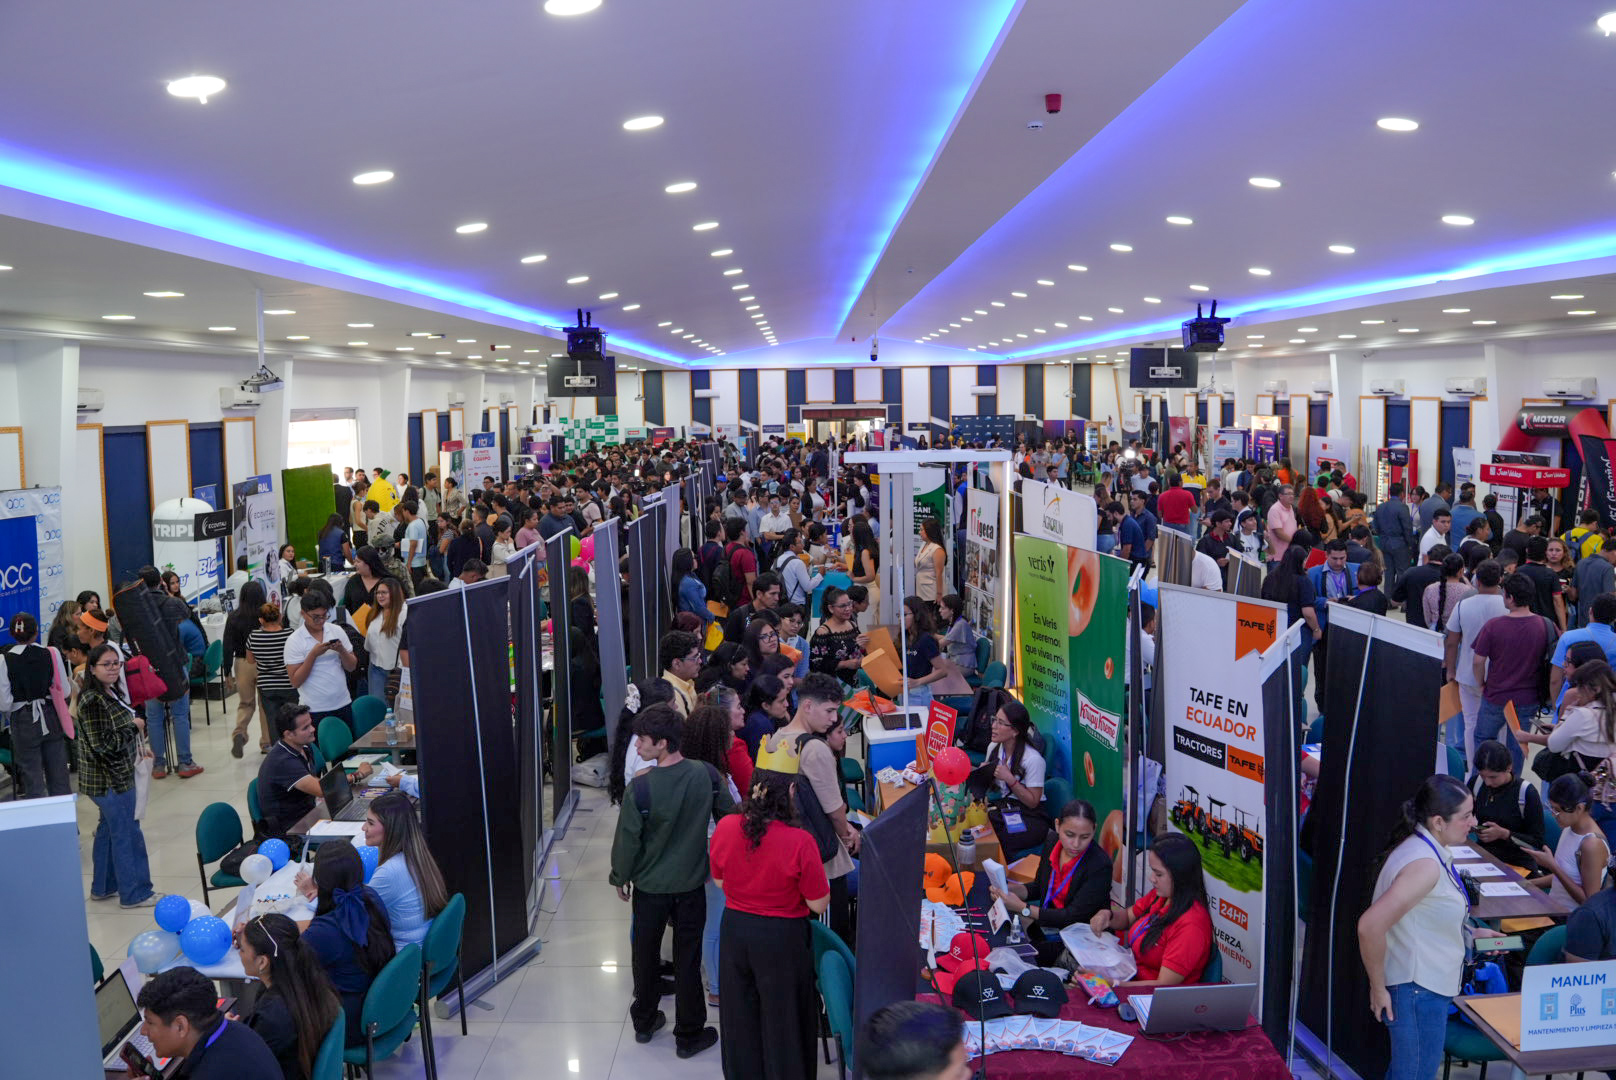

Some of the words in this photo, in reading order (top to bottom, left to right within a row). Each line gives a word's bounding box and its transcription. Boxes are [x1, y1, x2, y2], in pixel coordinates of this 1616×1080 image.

[1532, 415, 1566, 423] MOTOR
[258, 483, 270, 493] RAL
[1574, 475, 1587, 527] OTOR
[154, 524, 194, 538] TRIPL
[1028, 555, 1046, 572] veris
[1034, 613, 1041, 625] En
[1042, 616, 1057, 630] Veris
[1238, 619, 1265, 632] TAFE
[1025, 644, 1037, 656] que
[1037, 647, 1053, 662] vivas
[1031, 660, 1046, 674] vivas
[1027, 675, 1032, 687] y
[1032, 679, 1044, 690] que
[1190, 687, 1223, 711] TAFE
[1227, 698, 1248, 718] EN
[1186, 705, 1257, 742] ECUADOR
[1175, 733, 1223, 761] TRACTORES
[1229, 754, 1257, 771] TAFE
[1221, 903, 1247, 925] 24HP
[1213, 926, 1244, 953] UERZA,
[1551, 973, 1607, 989] MANLIM
[1528, 1026, 1579, 1036] MANTENIMIENTO
[1585, 1023, 1613, 1032] LIMPIEZA
